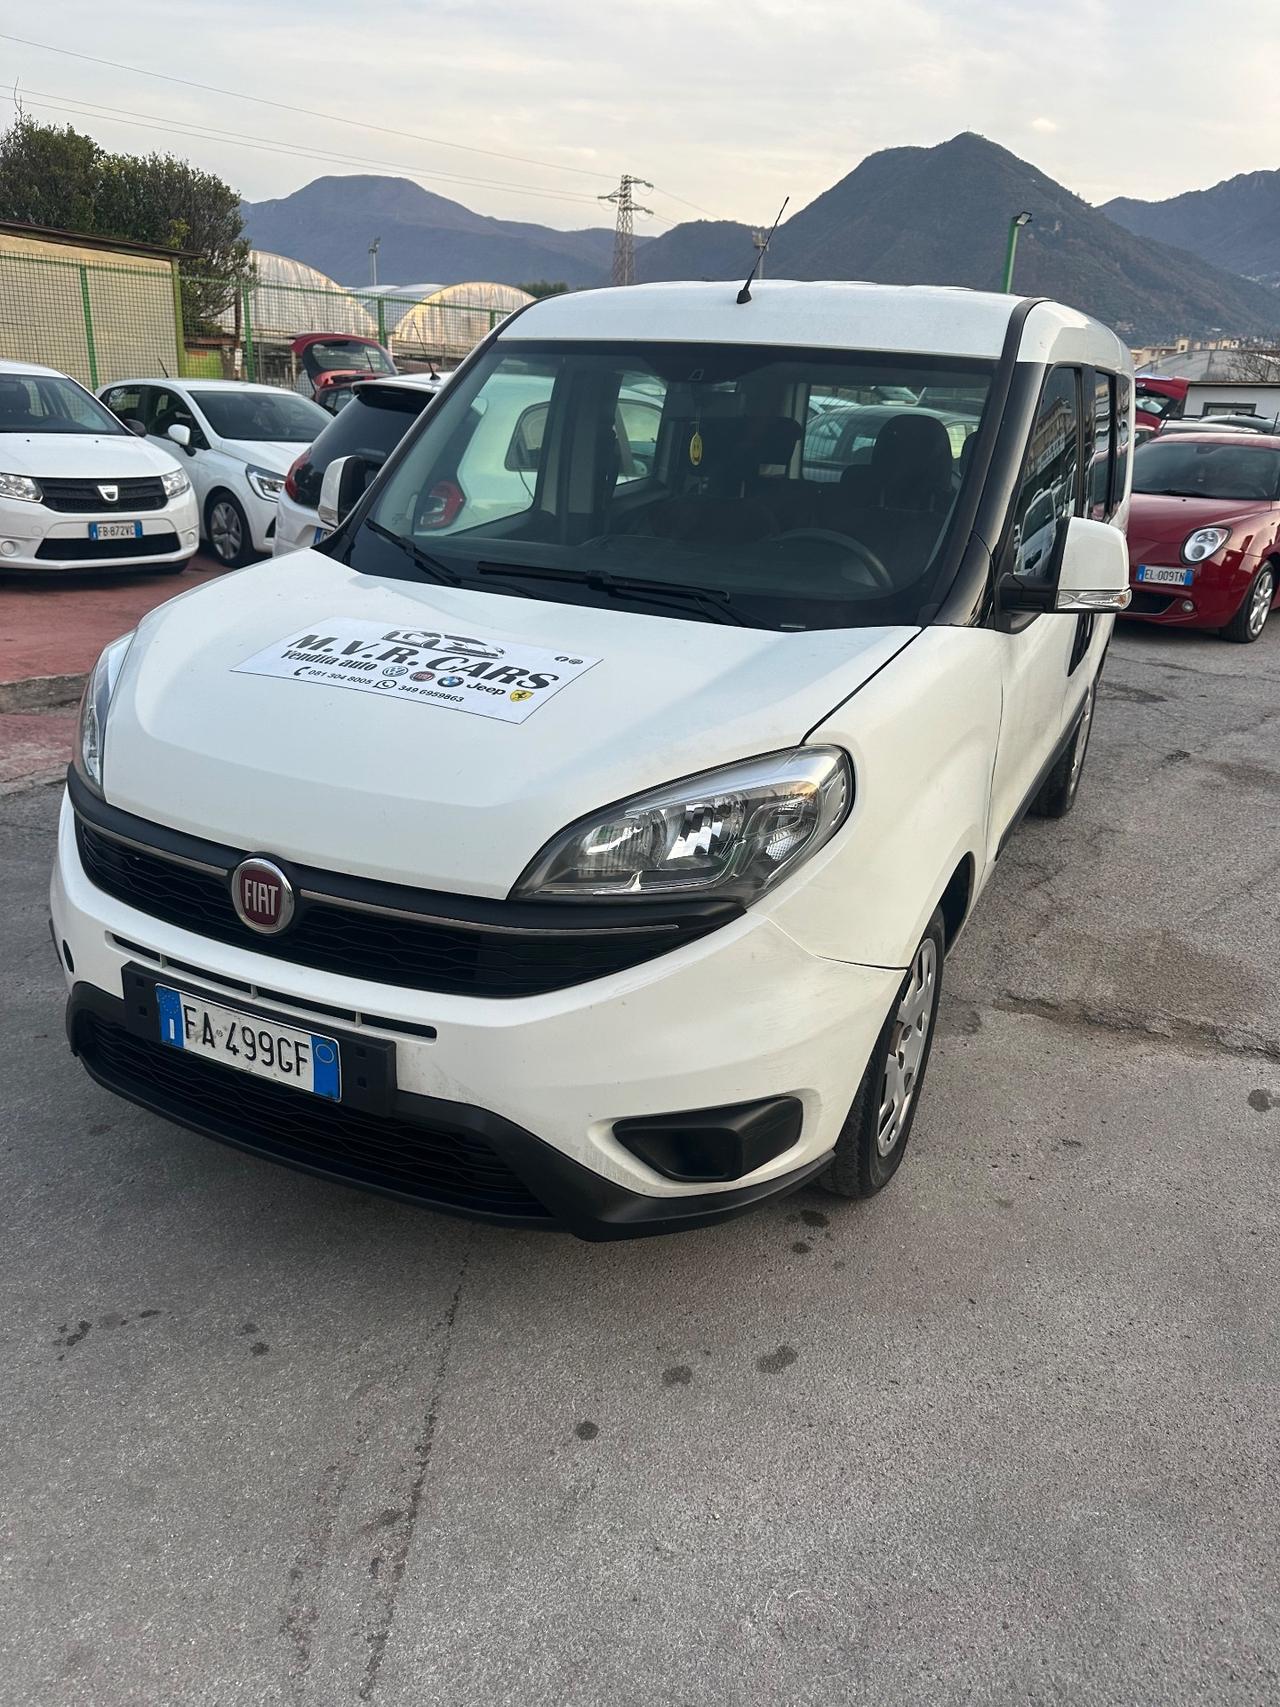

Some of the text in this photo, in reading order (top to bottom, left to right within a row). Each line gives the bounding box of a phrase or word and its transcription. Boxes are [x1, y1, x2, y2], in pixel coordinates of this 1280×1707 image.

[281, 650, 378, 671] Vendita auto
[308, 669, 328, 677] 081
[328, 672, 345, 680] 304
[398, 685, 419, 693] 349
[466, 682, 506, 696] Jeep
[244, 878, 279, 916] FIAT
